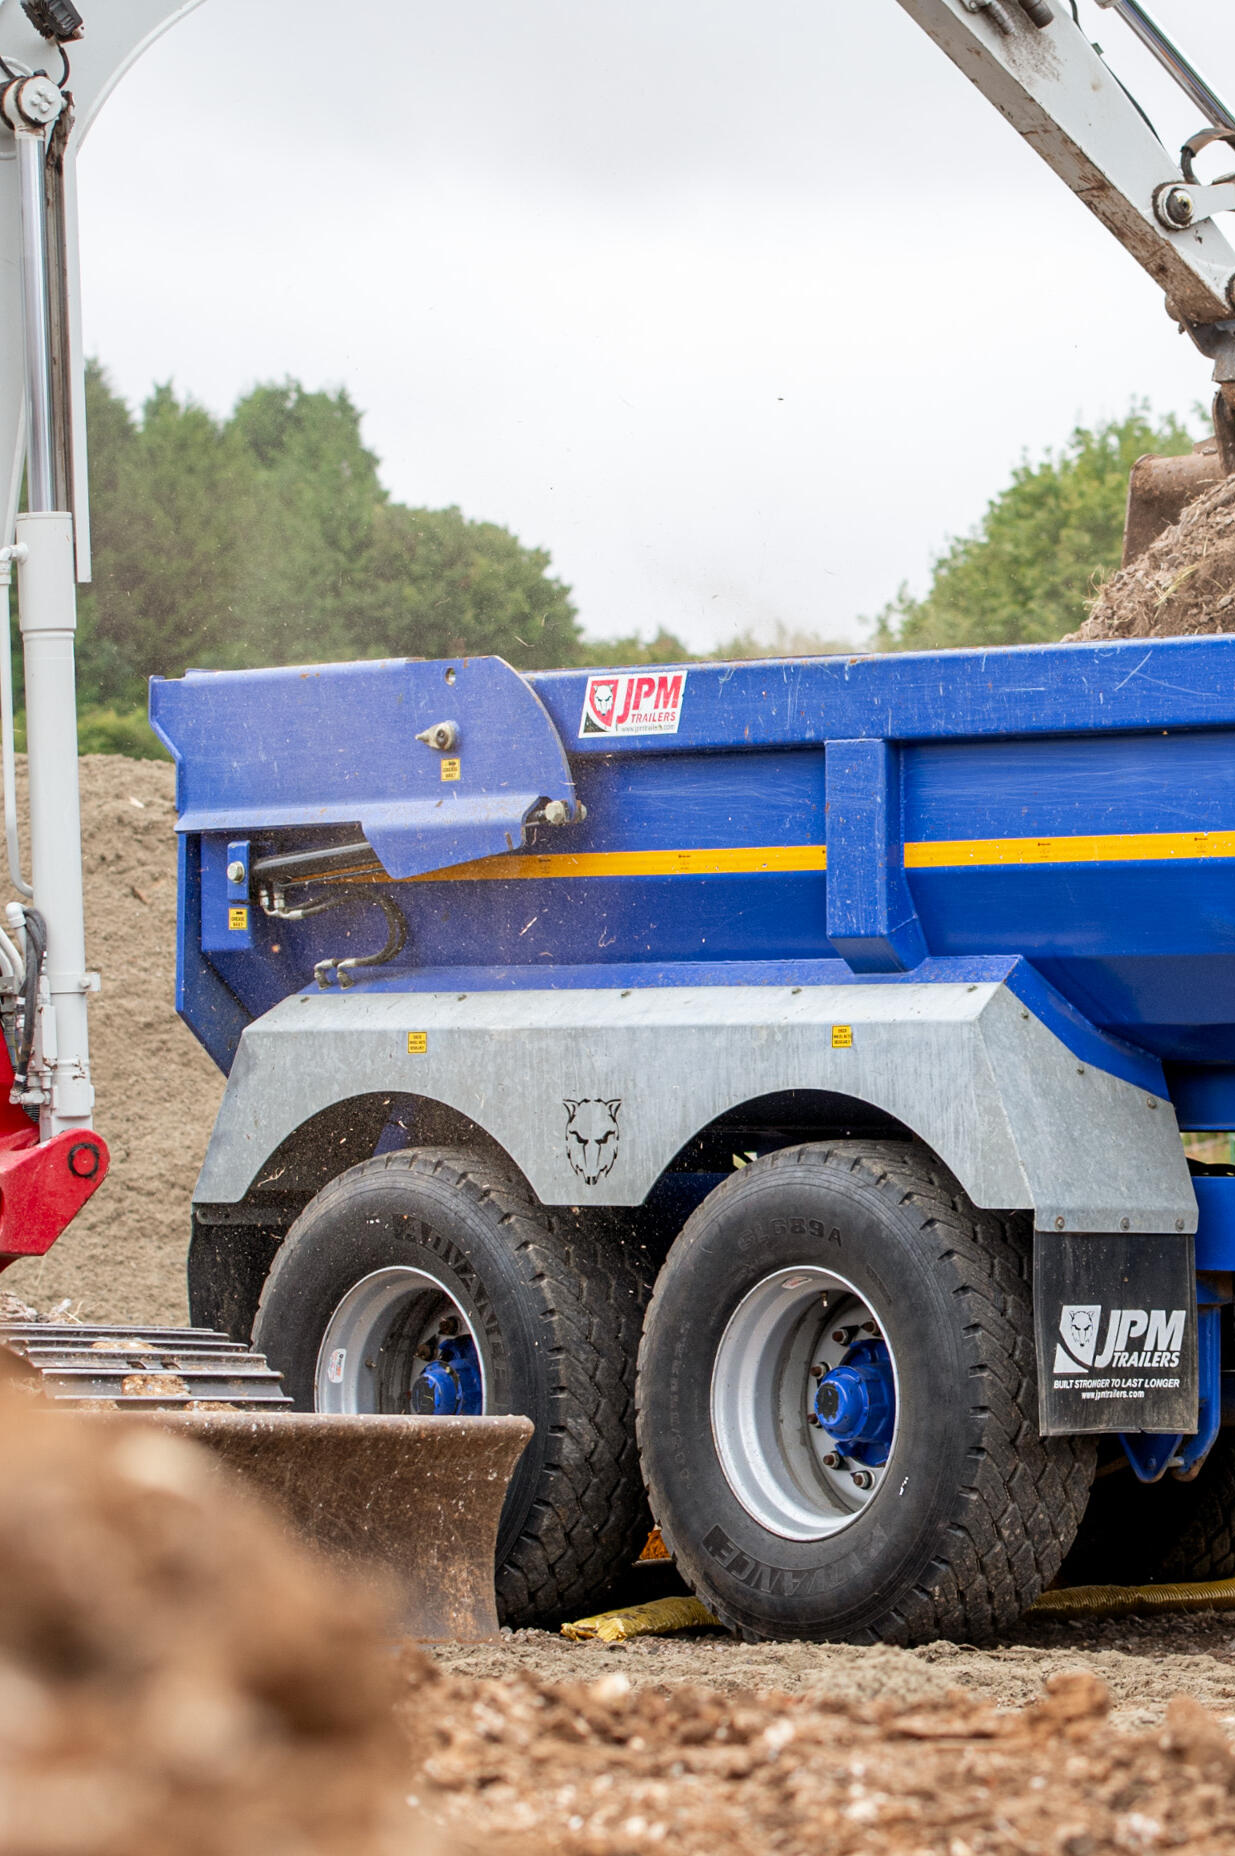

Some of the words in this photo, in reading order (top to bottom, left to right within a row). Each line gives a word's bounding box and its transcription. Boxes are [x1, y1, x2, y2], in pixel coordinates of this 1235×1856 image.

[616, 675, 683, 725] JPM
[631, 711, 676, 723] TRAILERS
[1094, 1309, 1187, 1369] JPM
[1112, 1351, 1181, 1368] TRAILERS
[1053, 1379, 1074, 1389] BUILT
[1074, 1379, 1110, 1389] STRONGER
[1111, 1379, 1120, 1388] TO
[1121, 1378, 1144, 1388] LAST
[1144, 1378, 1180, 1388] LONGER
